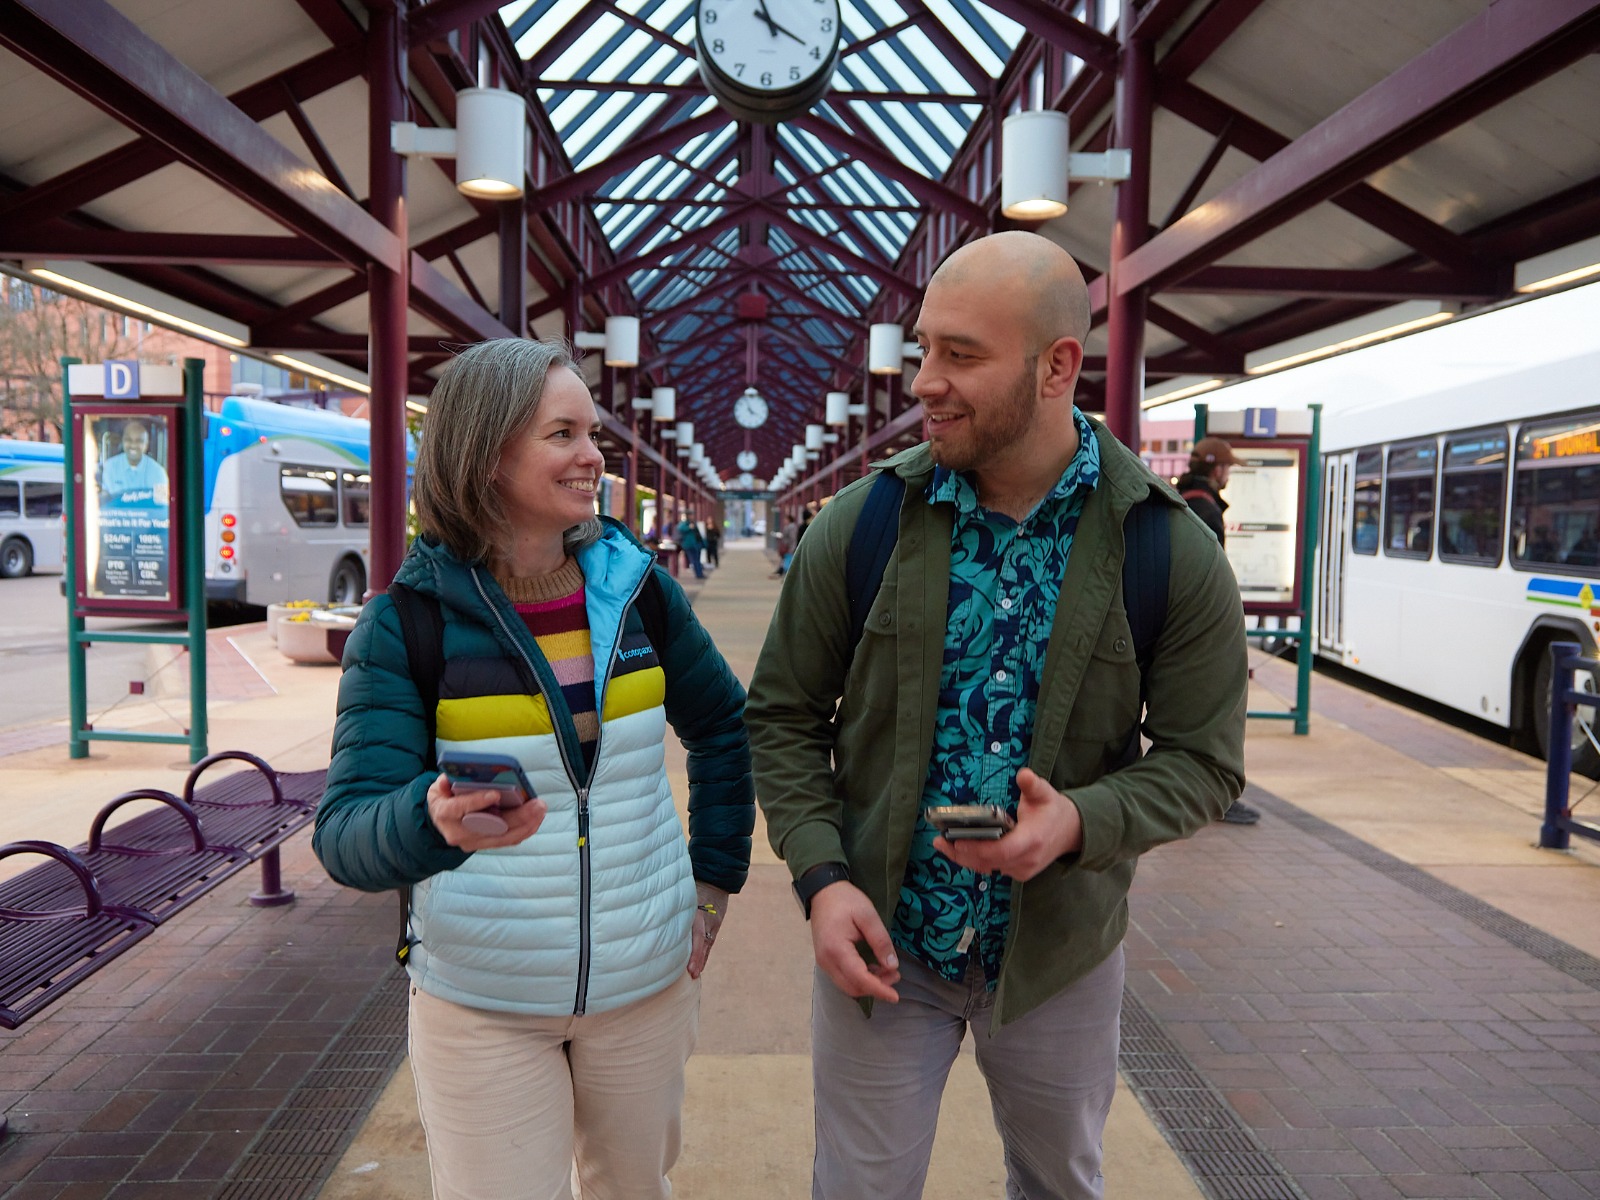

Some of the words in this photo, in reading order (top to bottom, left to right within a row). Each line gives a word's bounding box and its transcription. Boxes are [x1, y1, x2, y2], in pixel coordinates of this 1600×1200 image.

[705, 9, 717, 24] 9
[820, 18, 832, 32] 3
[713, 39, 725, 53] 8
[809, 46, 821, 60] 4
[734, 63, 746, 77] 7
[789, 67, 800, 80] 5
[760, 72, 772, 86] 6
[110, 363, 132, 396] D
[1253, 408, 1269, 434] L
[107, 560, 125, 570] PTO
[138, 560, 160, 571] PAID
[623, 645, 653, 659] cotopaxi
